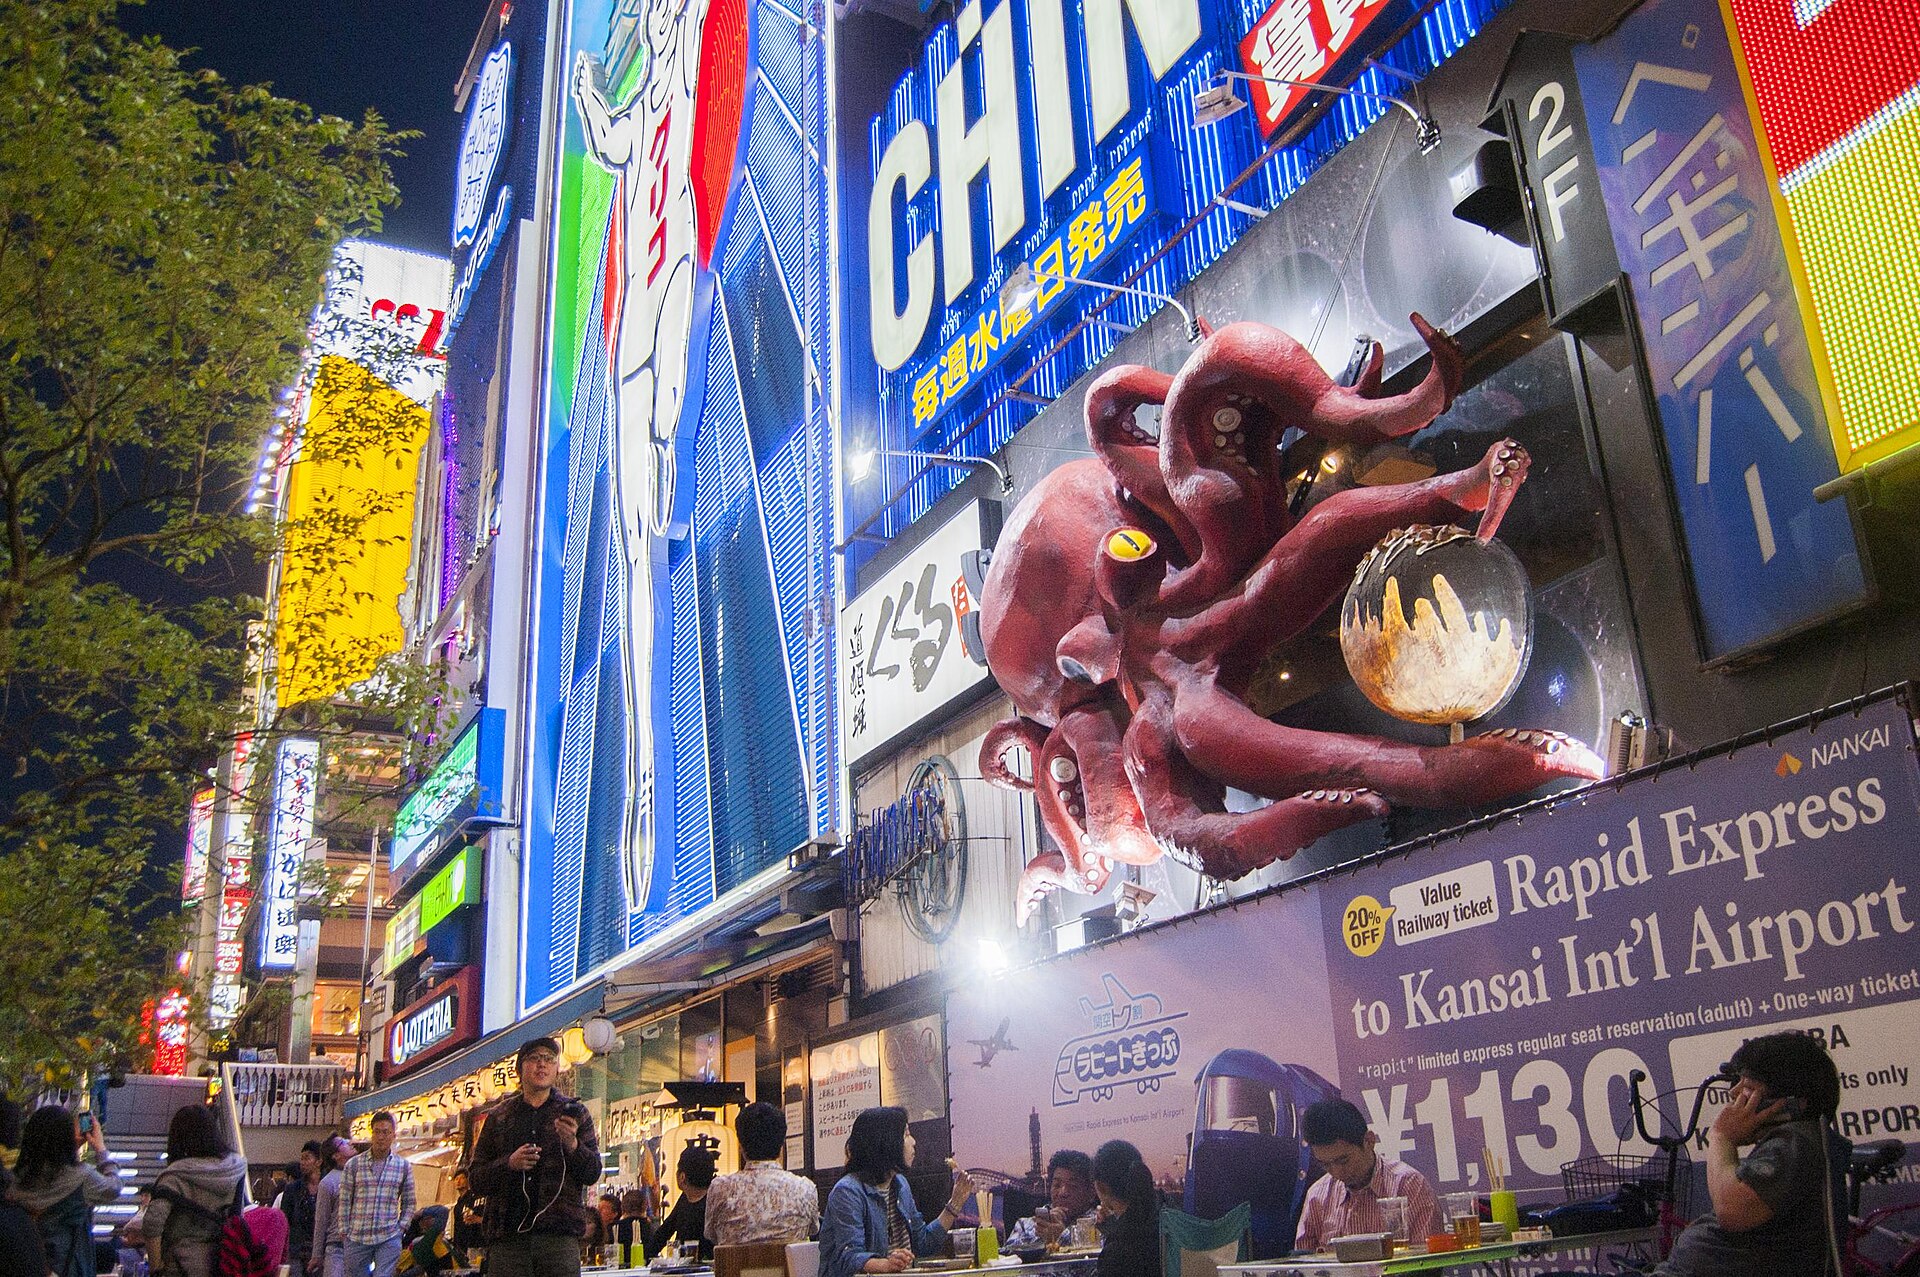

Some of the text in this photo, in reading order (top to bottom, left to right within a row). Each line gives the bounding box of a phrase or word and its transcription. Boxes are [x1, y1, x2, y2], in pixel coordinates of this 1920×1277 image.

[1528, 81, 1580, 243] 2F
[646, 93, 674, 290] グリコ
[866, 563, 953, 693] くくる
[849, 613, 867, 738] 道頓堀
[1811, 724, 1890, 769] NANKAI
[1503, 777, 1887, 922] Rapid Express
[1347, 907, 1381, 931] 20%
[1398, 896, 1493, 937] Railway ticket
[1419, 882, 1462, 906] Value
[1351, 928, 1379, 949] OFF
[1351, 877, 1914, 1039] to Kansai Int'l Airport
[404, 995, 452, 1050] LOTTERIA
[1417, 1050, 1459, 1071] limited
[1464, 1042, 1513, 1065] express
[1517, 1033, 1566, 1056] regular
[1571, 1025, 1603, 1045] seat
[1606, 1010, 1696, 1039] reservation
[1697, 996, 1753, 1026] (adult)
[1773, 983, 1855, 1012] One-way
[1860, 969, 1920, 998] ticket
[1077, 1033, 1178, 1078] ラピートきっぷ
[1866, 1064, 1909, 1087] only
[1102, 1118, 1122, 1127] Express
[1163, 1109, 1184, 1118] Airport
[1361, 1048, 1661, 1186] ¥1,130
[1832, 1103, 1920, 1138] RPOR
